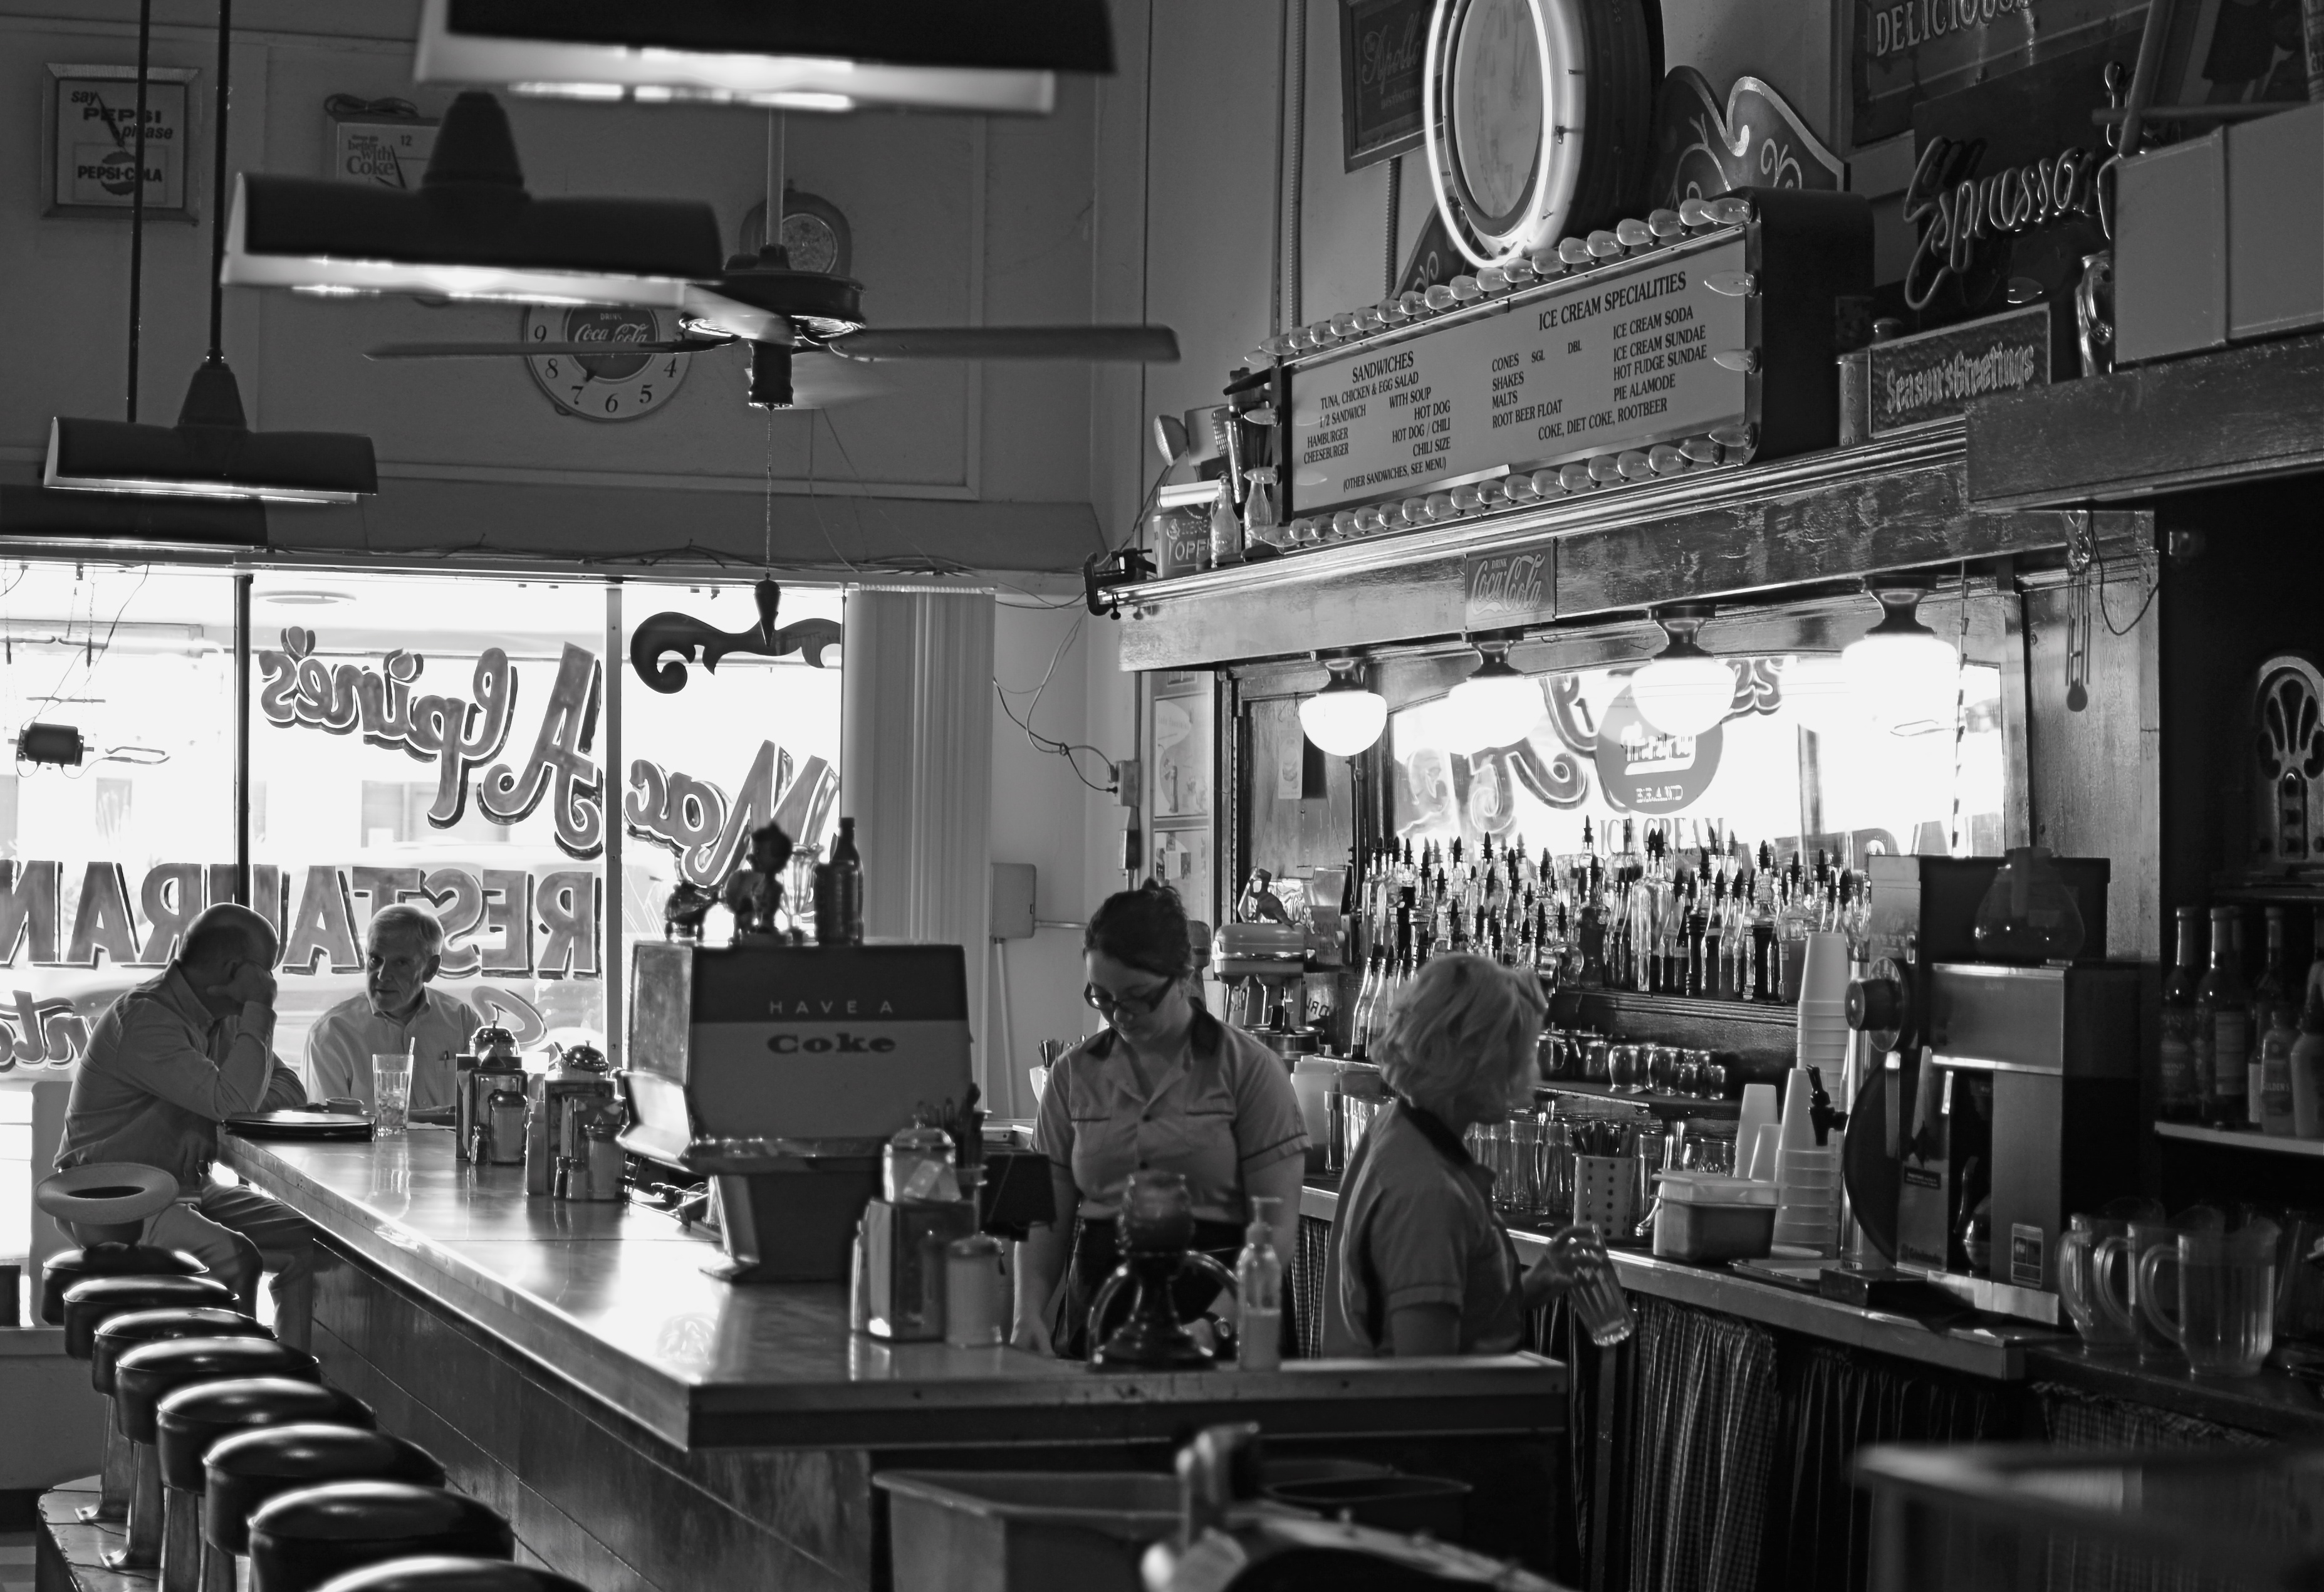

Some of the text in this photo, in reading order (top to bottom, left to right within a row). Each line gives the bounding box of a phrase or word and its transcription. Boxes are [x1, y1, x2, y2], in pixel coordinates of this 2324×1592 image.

[71, 90, 97, 106] say
[122, 125, 174, 141] plase
[400, 135, 412, 146] 12
[78, 165, 162, 182] PEPSI-CLA
[347, 155, 394, 175] Coke
[1539, 271, 1686, 331] ICE CREAM SPECIALITIES
[600, 313, 622, 321] DRINK
[1613, 305, 1694, 340] ICE CREAM SODA
[534, 325, 547, 342] 9
[1613, 325, 1706, 362] ICE CREAM SUNDAE
[1492, 340, 1582, 372] CONES SGL DBL
[1613, 344, 1707, 381] HOT FUDGE SUNDAE
[545, 358, 559, 379] 8
[663, 357, 677, 378] 4
[1352, 350, 1414, 384] SANDWICHES
[1492, 371, 1524, 392] SHAKES
[1613, 373, 1675, 402] PIE ALAMODE
[1887, 342, 2034, 414] Season's Greetings
[571, 385, 584, 405] 7
[639, 384, 653, 404] 5
[1320, 371, 1419, 411] TUNA, CHICKEN & EGG SALAD
[1492, 390, 1518, 409] MALTS
[605, 392, 619, 413] 6
[1319, 386, 1431, 429] 1/2 SANDWICH WITH SOUP
[1414, 399, 1451, 421] HOT DOG
[1492, 399, 1563, 429] ROOT BEER FLOAT
[1538, 397, 1667, 441] COKE, DIET COKE, ROOTBEER
[1307, 427, 1348, 449] HAMBURGER
[1392, 417, 1451, 443] HOT DOG / CHILI
[1303, 443, 1349, 464] CHEESEBURGER
[1413, 436, 1451, 456] CHILI SIZE
[1343, 456, 1446, 493] (OTHER SANDWICHES, SEE MENU)
[1491, 558, 1508, 569] DRINK
[769, 1000, 894, 1015] HAVE A
[766, 1032, 897, 1054] Coke
